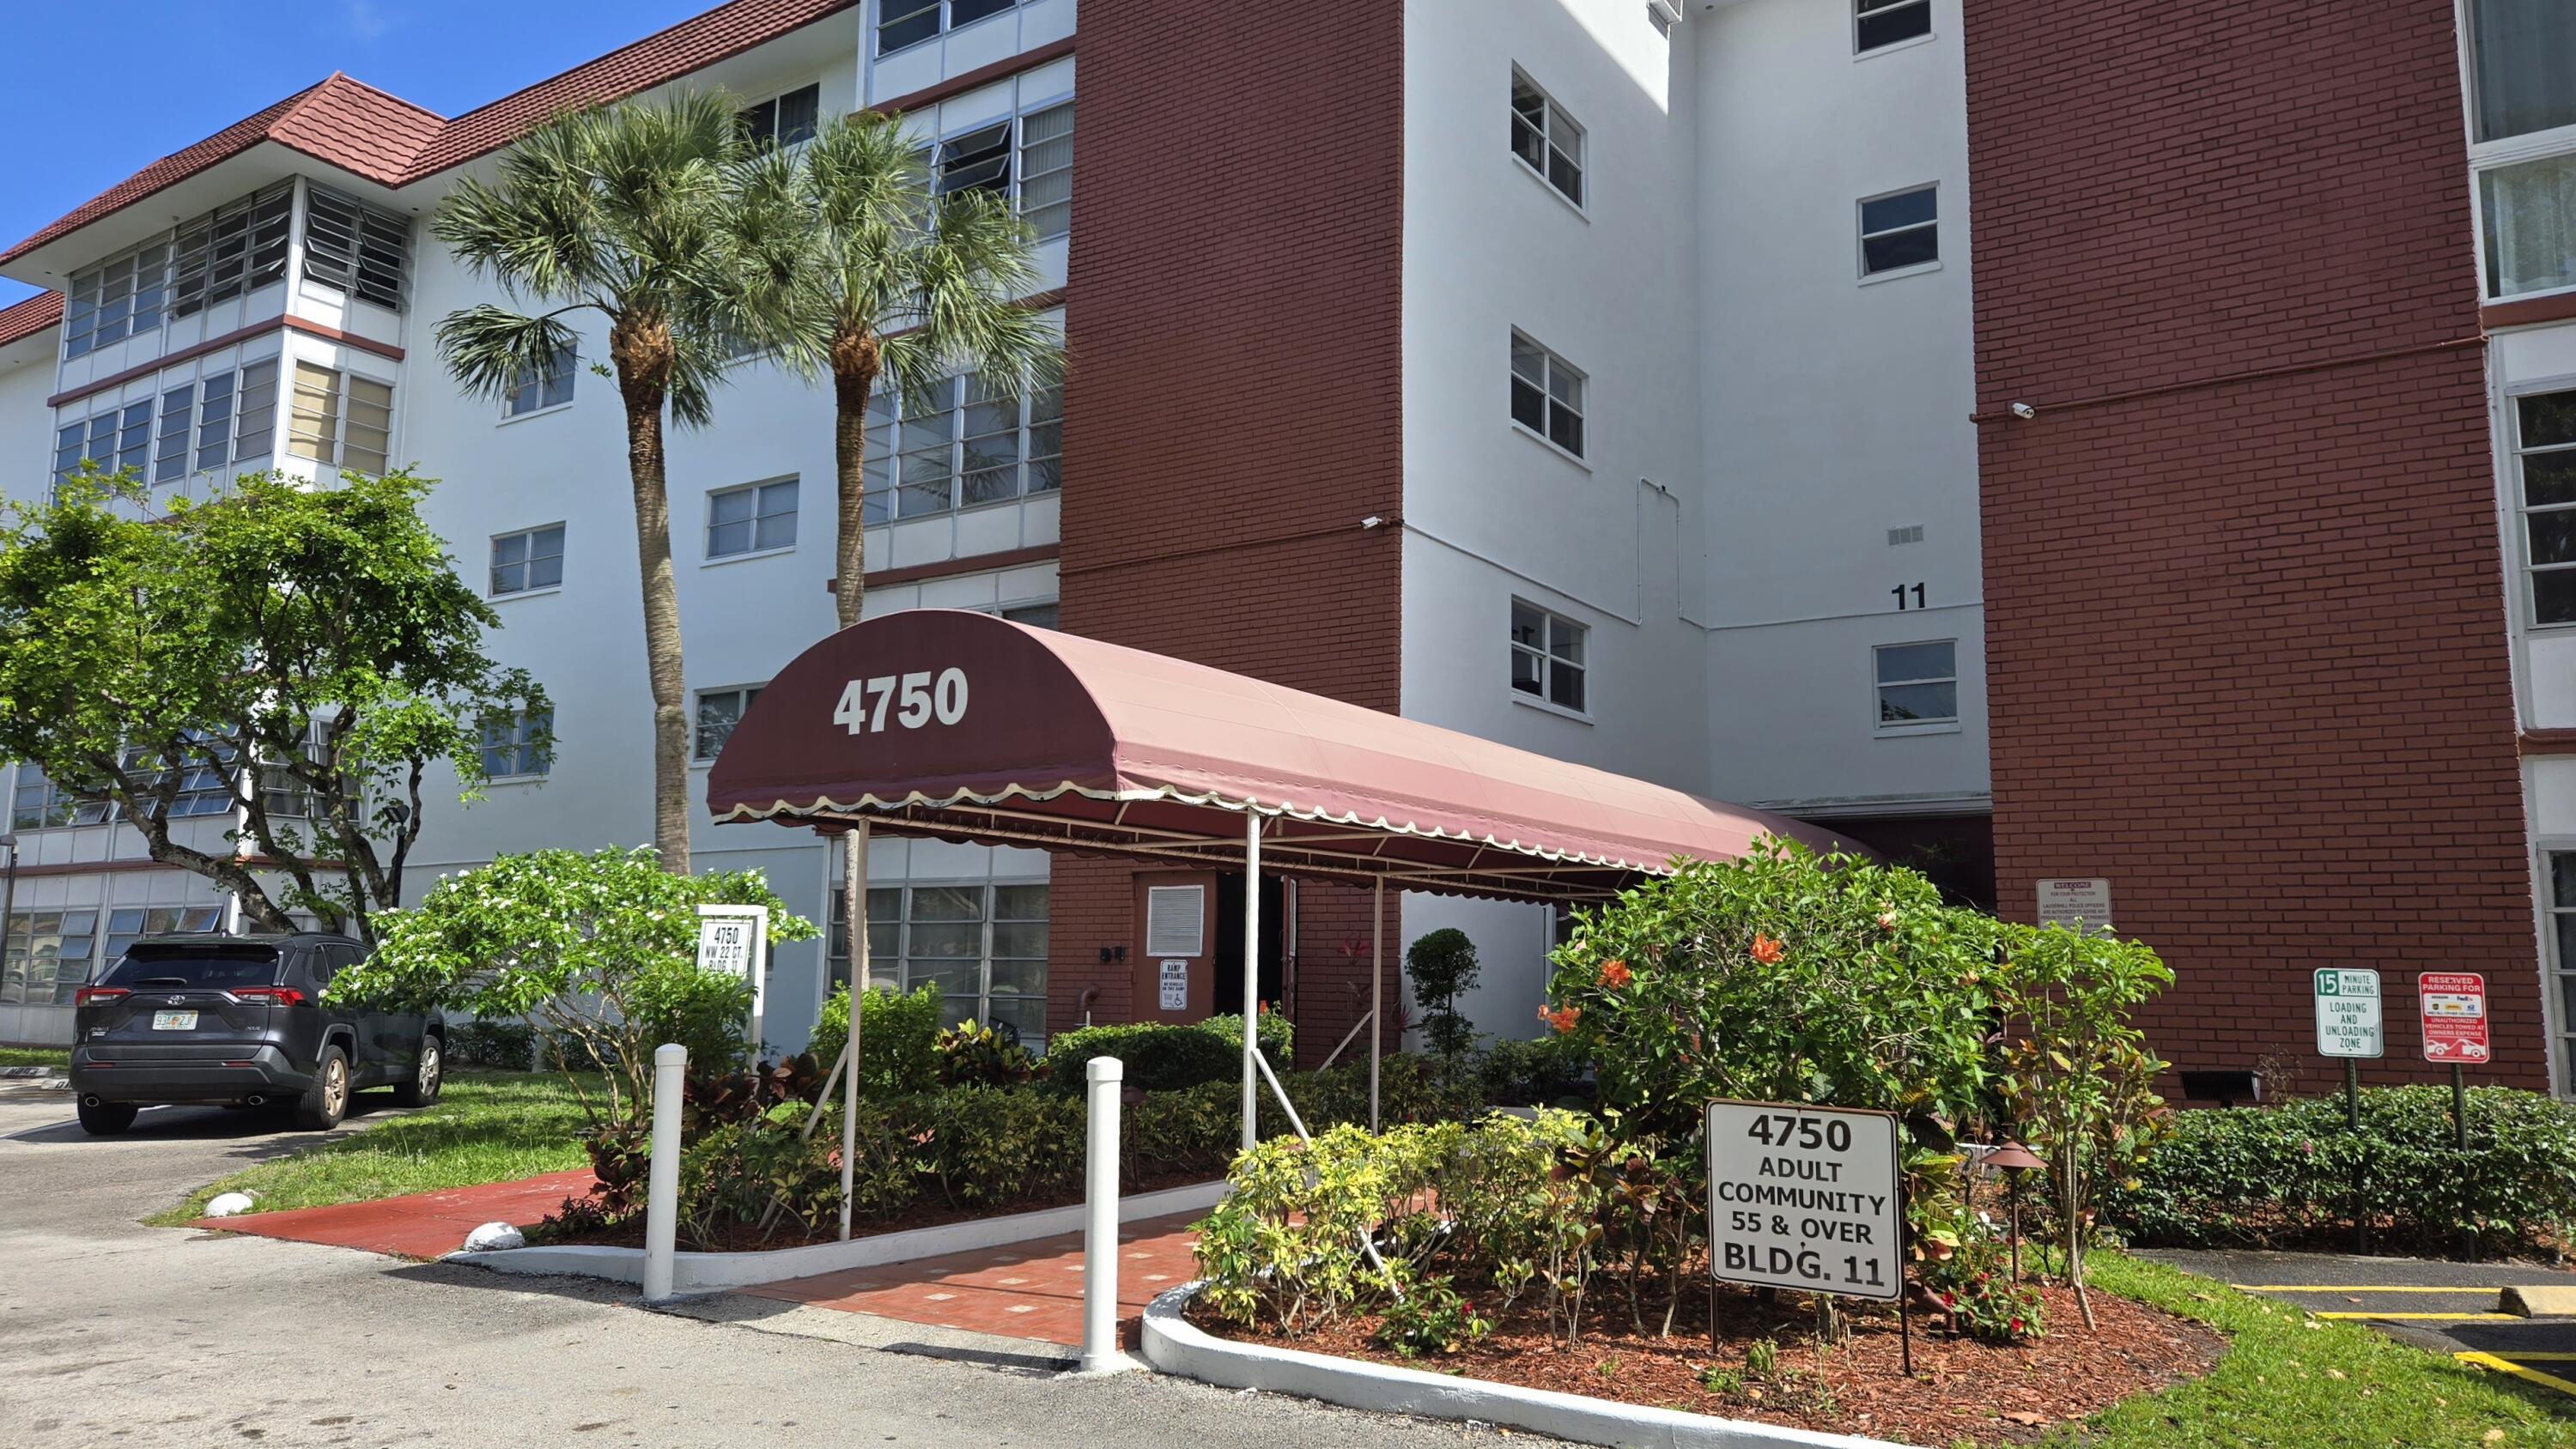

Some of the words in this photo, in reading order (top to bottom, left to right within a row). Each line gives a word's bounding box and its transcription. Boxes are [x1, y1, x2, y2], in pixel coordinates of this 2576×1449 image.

[1892, 582, 1925, 610] 11
[833, 667, 969, 736] 4750
[714, 927, 739, 944] 4750
[705, 946, 718, 958] NW
[720, 946, 730, 958] 22
[732, 946, 744, 959] CT.
[2318, 973, 2337, 993] 15
[2344, 975, 2370, 985] MINUTE
[2428, 976, 2474, 985] RESERVED
[2342, 985, 2374, 994] PARKING
[2330, 1002, 2366, 1013] LOADING
[2341, 1015, 2357, 1025] AND
[2325, 1025, 2374, 1037] UNLOADING
[2340, 1038, 2361, 1048] ZONE
[1747, 1114, 1851, 1152] 4750
[1759, 1156, 1843, 1182] ADULT
[1718, 1181, 1886, 1216] COMMUNITY
[1731, 1210, 1761, 1233] 55
[1771, 1215, 1791, 1236] &
[1801, 1218, 1874, 1246] OVER
[1724, 1242, 1831, 1281] BLDG.
[1844, 1256, 1885, 1287] 11
